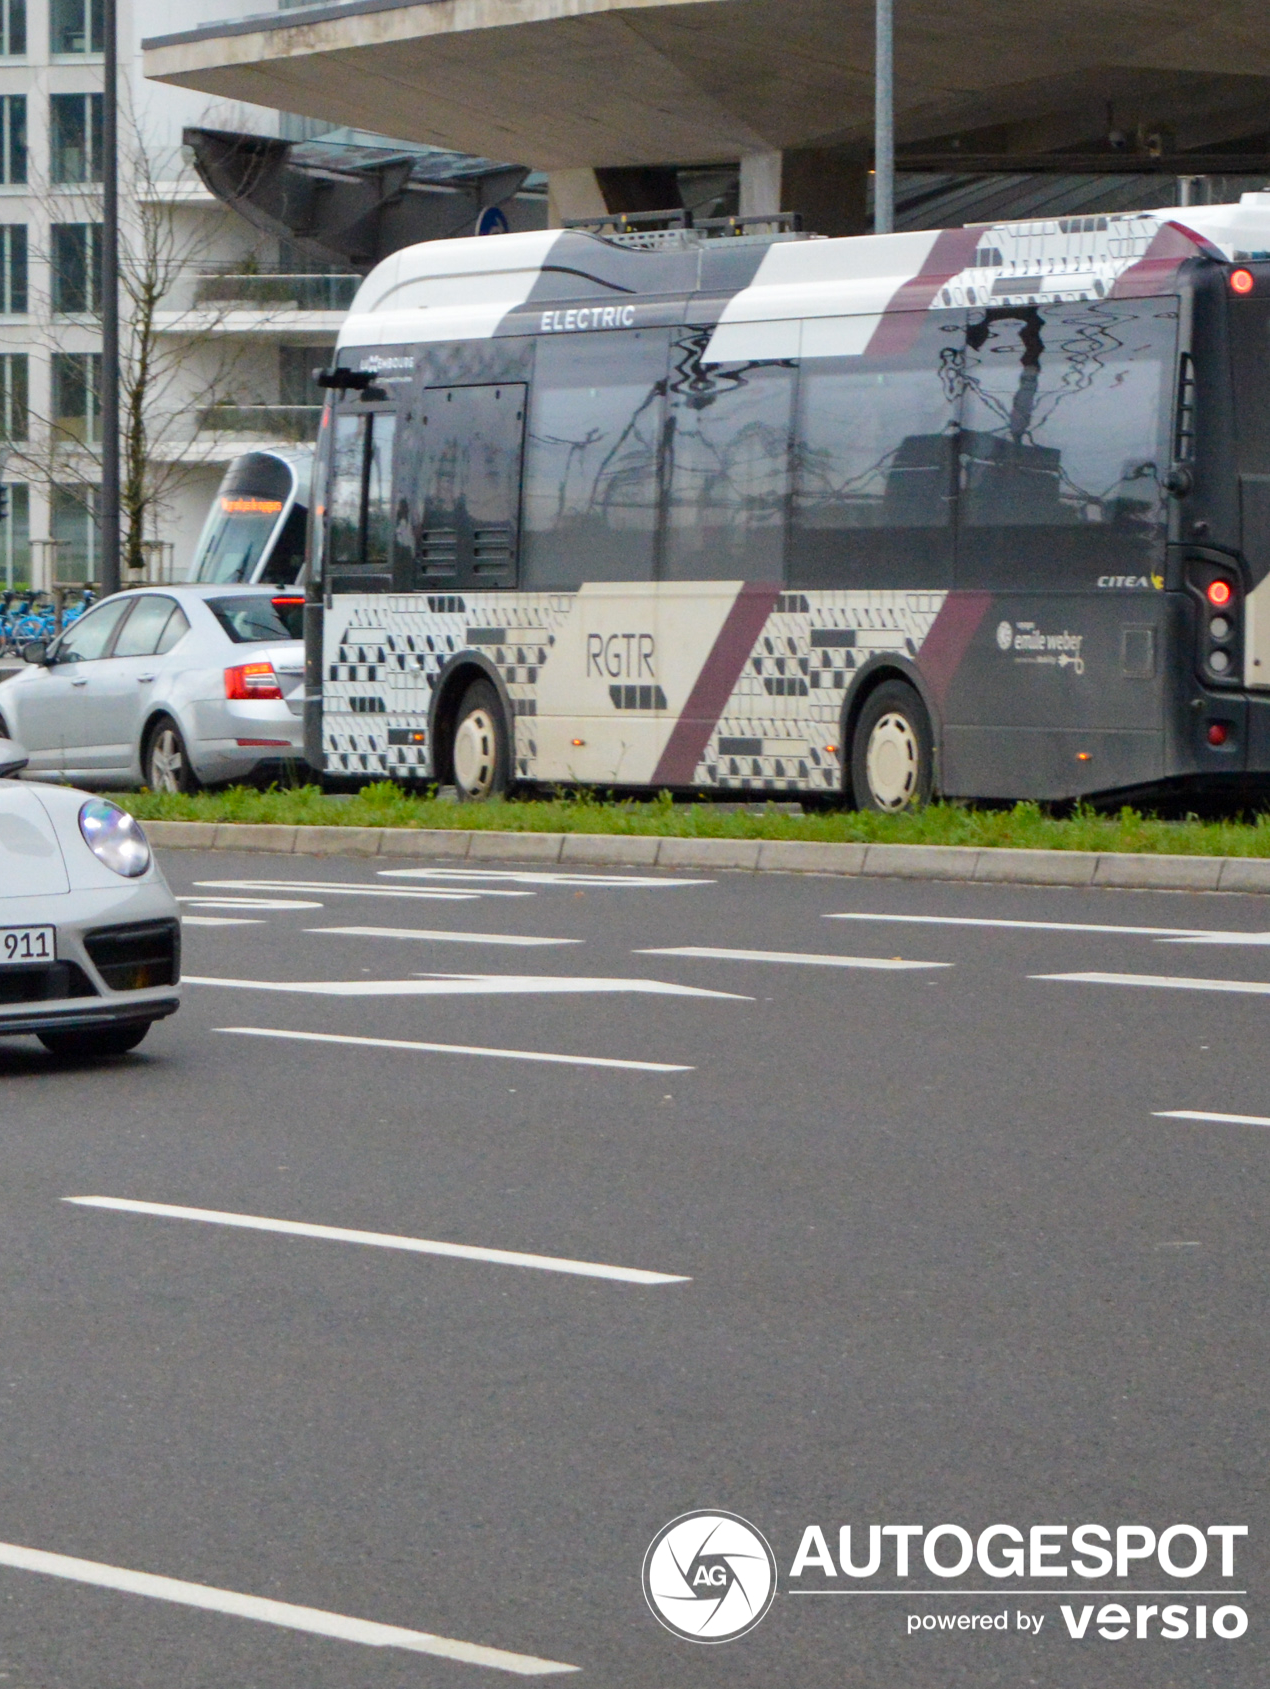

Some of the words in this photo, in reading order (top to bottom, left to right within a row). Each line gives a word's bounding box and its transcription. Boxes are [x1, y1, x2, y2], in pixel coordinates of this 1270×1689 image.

[540, 305, 636, 331] ELECTRIC
[1096, 575, 1149, 588] CITEA
[1014, 629, 1046, 650] emile
[1047, 629, 1084, 651] weber
[586, 633, 656, 678] RGTR
[4, 932, 50, 960] 911
